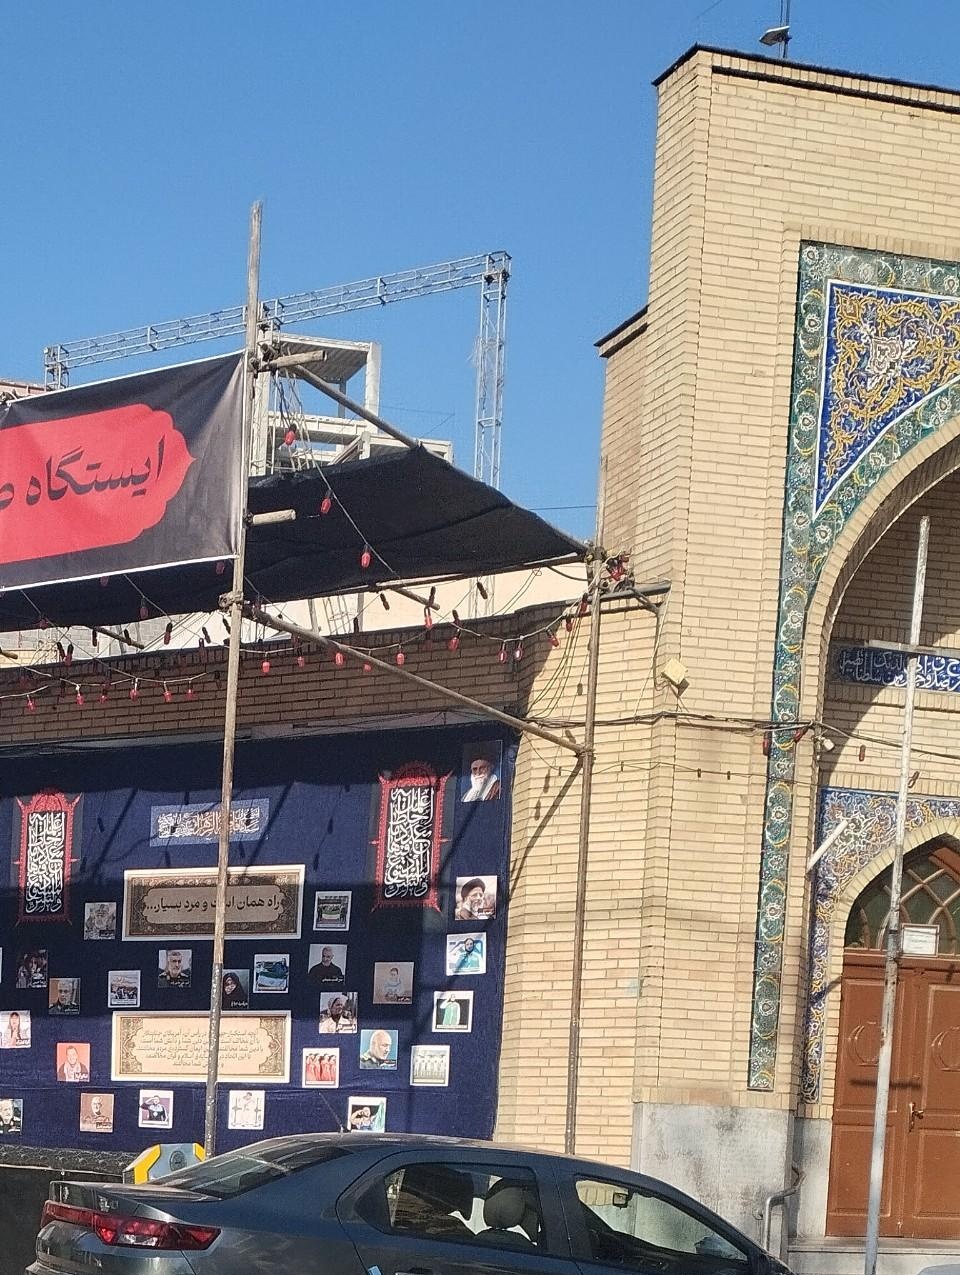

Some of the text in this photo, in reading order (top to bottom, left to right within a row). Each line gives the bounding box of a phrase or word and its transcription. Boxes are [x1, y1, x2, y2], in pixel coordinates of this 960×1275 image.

[26, 434, 166, 506] ایستگاه
[185, 901, 200, 912] مرد
[236, 895, 265, 911] همان
[266, 894, 281, 911] راه
